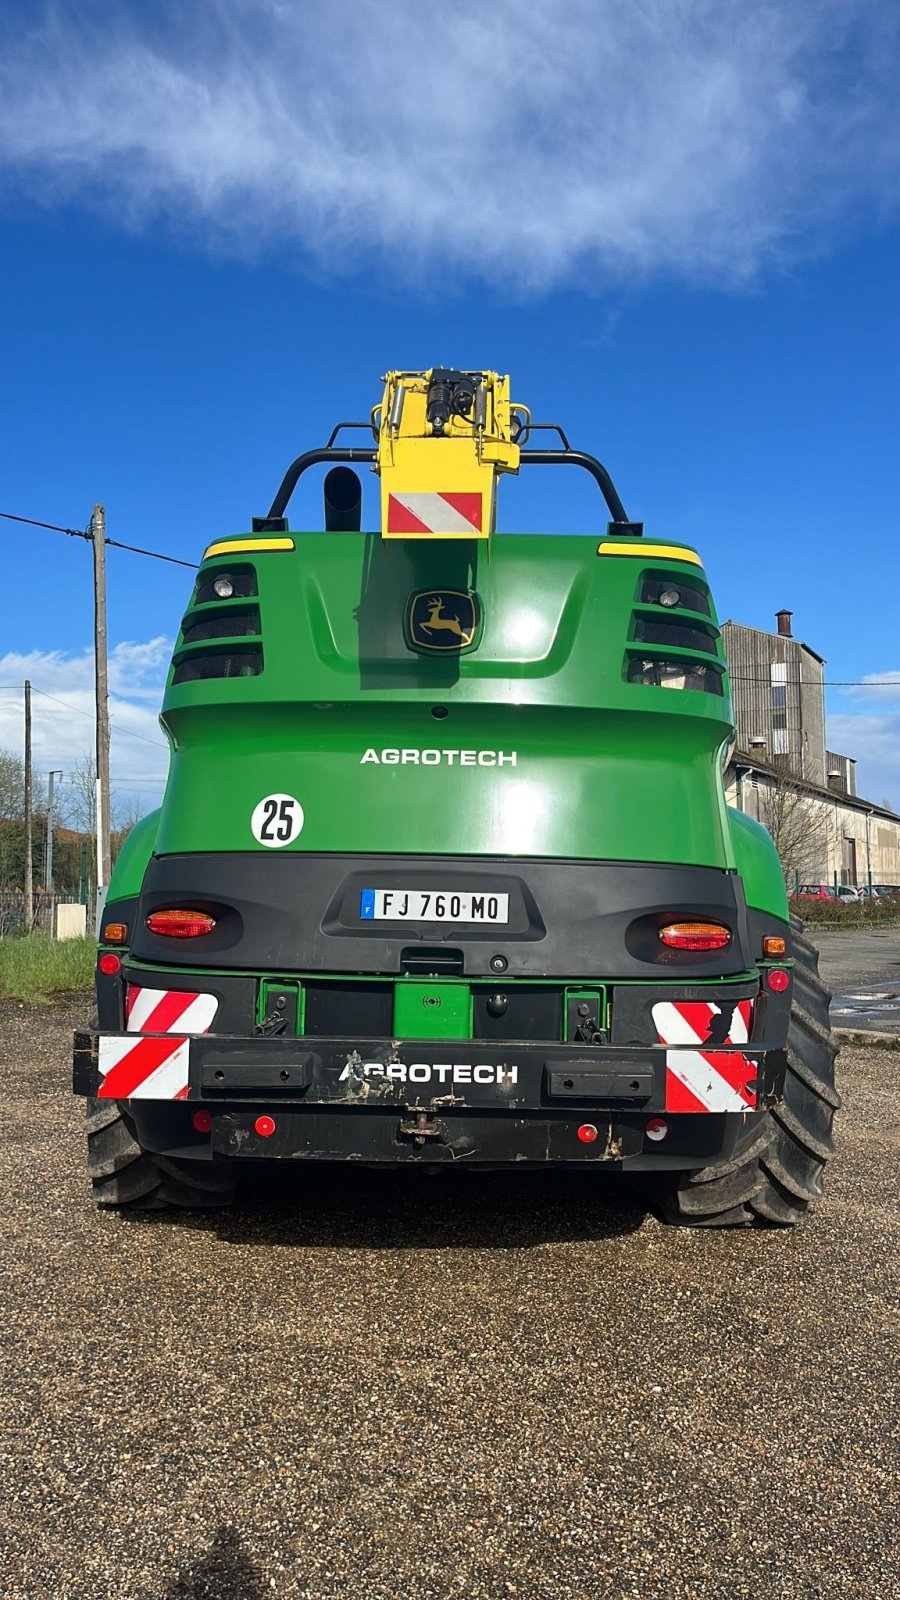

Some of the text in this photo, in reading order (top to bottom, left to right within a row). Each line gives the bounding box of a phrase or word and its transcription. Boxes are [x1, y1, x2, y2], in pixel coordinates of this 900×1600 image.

[359, 748, 517, 767] AGROTECH
[260, 799, 295, 841] 25
[365, 906, 371, 914] F
[382, 893, 499, 920] FJ 760 MQ
